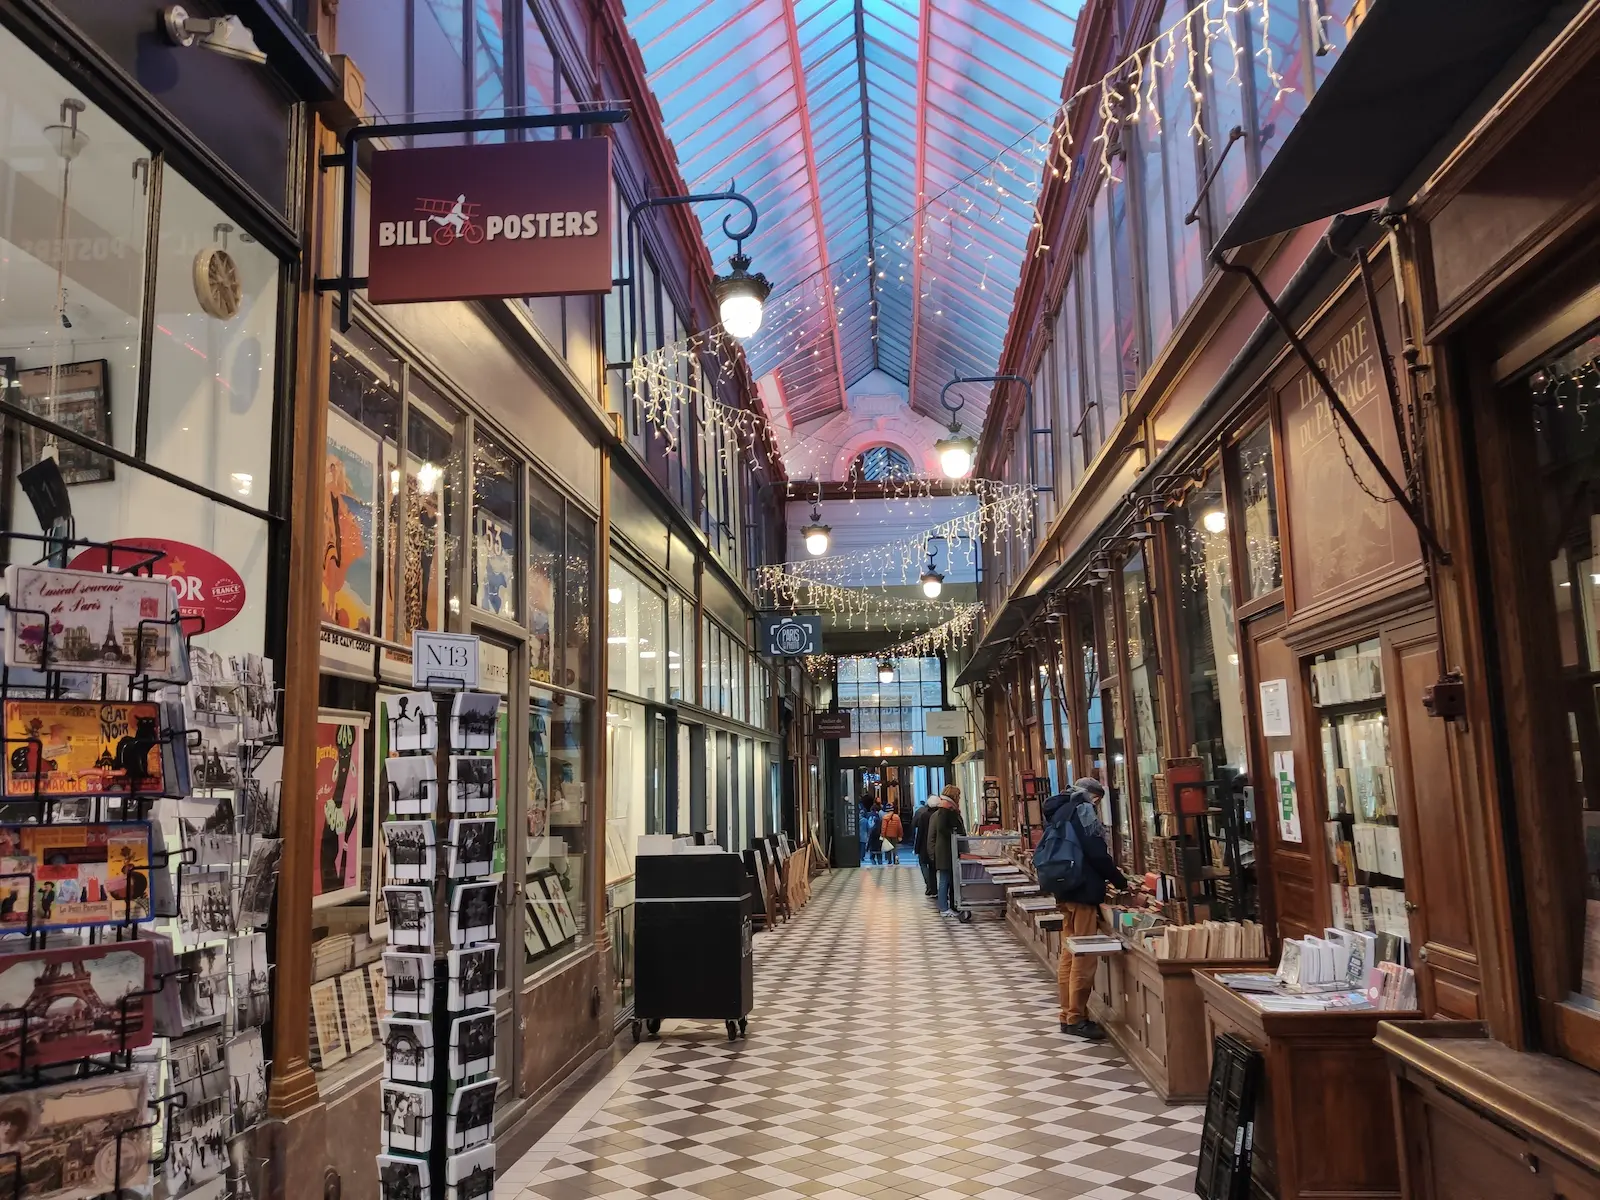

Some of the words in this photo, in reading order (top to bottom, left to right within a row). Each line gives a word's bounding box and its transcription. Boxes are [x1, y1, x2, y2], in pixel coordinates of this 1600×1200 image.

[379, 219, 432, 247] BILL
[486, 210, 598, 241] POSTERS
[1315, 355, 1377, 435] PASAGE
[484, 519, 502, 556] 53
[212, 584, 238, 596] FRANCE
[51, 600, 64, 613] de
[69, 598, 101, 612] Paris
[782, 628, 800, 642] PARIS
[101, 704, 128, 723] CHAT
[101, 723, 128, 744] NOIR
